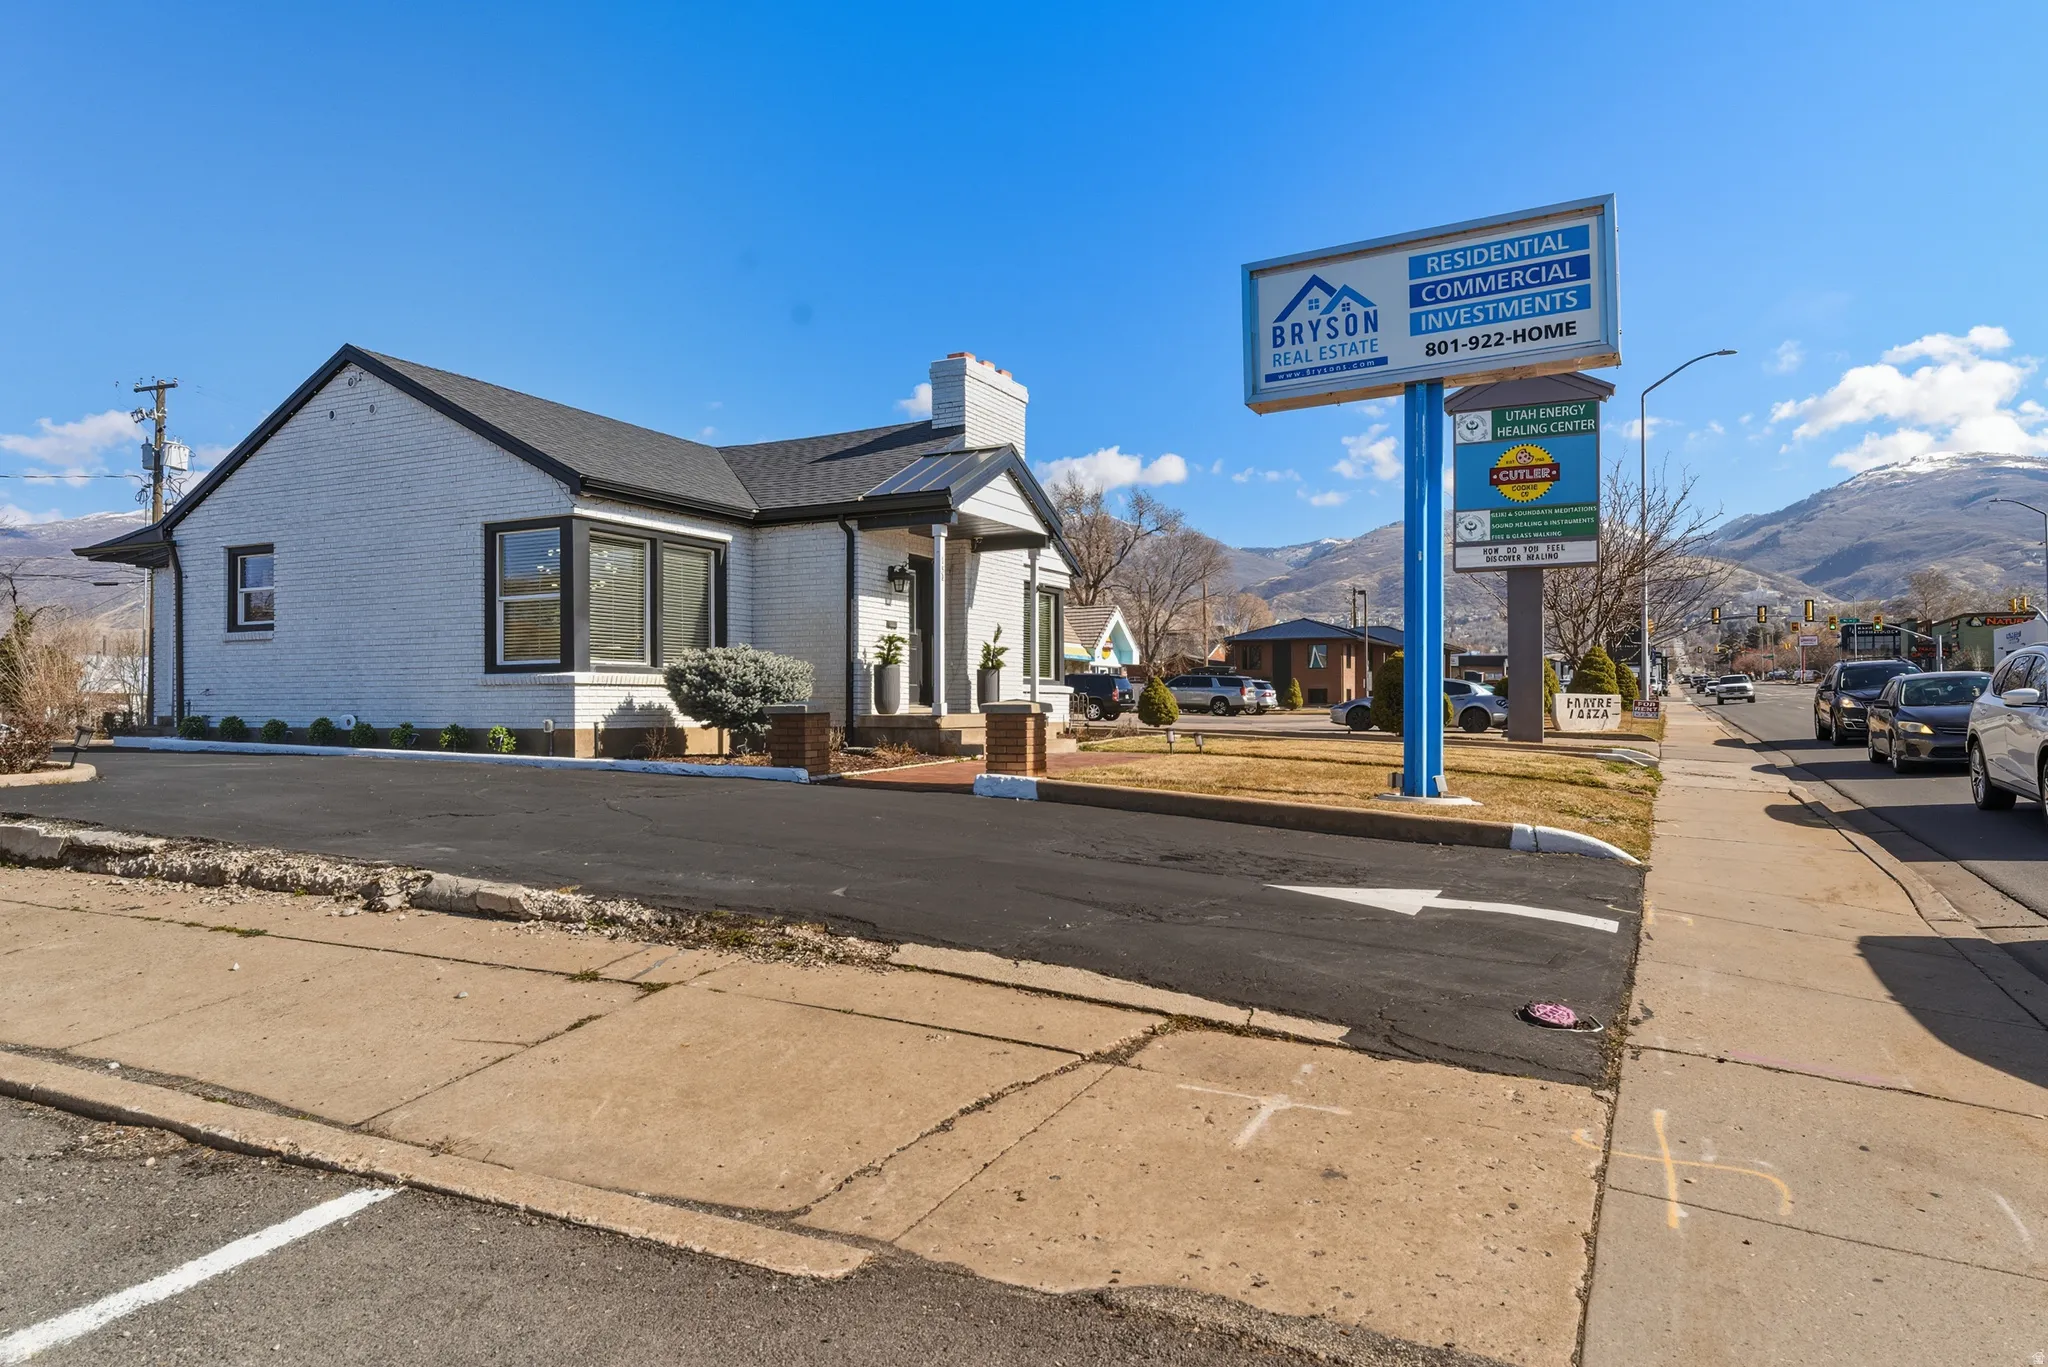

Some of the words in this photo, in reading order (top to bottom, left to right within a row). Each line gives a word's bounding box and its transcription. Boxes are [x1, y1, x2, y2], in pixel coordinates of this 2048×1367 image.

[1427, 233, 1570, 273] RESIDENTIAL
[1421, 261, 1577, 302] COMMERCIAL
[1421, 290, 1578, 331] INVESTMENTS
[1272, 309, 1379, 348] BRYSON
[1425, 321, 1577, 357] 801-922-HOME
[1272, 349, 1313, 368] REAL
[1319, 338, 1379, 360] ESTATE
[1505, 409, 1537, 421] UTAH
[1539, 404, 1586, 419] ENERGY
[1497, 423, 1548, 437] HEALING
[1550, 419, 1596, 433] CENTER
[1499, 467, 1551, 481] CUTLER
[1511, 484, 1538, 492] COOKIE
[1554, 505, 1597, 514] MEDITATIONS
[1491, 522, 1514, 530] SOUND
[1514, 520, 1543, 528] HEALING
[1549, 517, 1595, 525] INSTRUMENTS
[1532, 530, 1562, 538] WALKING
[1483, 547, 1499, 555] HOW
[1506, 546, 1517, 554] DO
[1523, 545, 1539, 553] YOU
[1546, 544, 1566, 552] FEEL
[1485, 554, 1522, 563] DISCOVER
